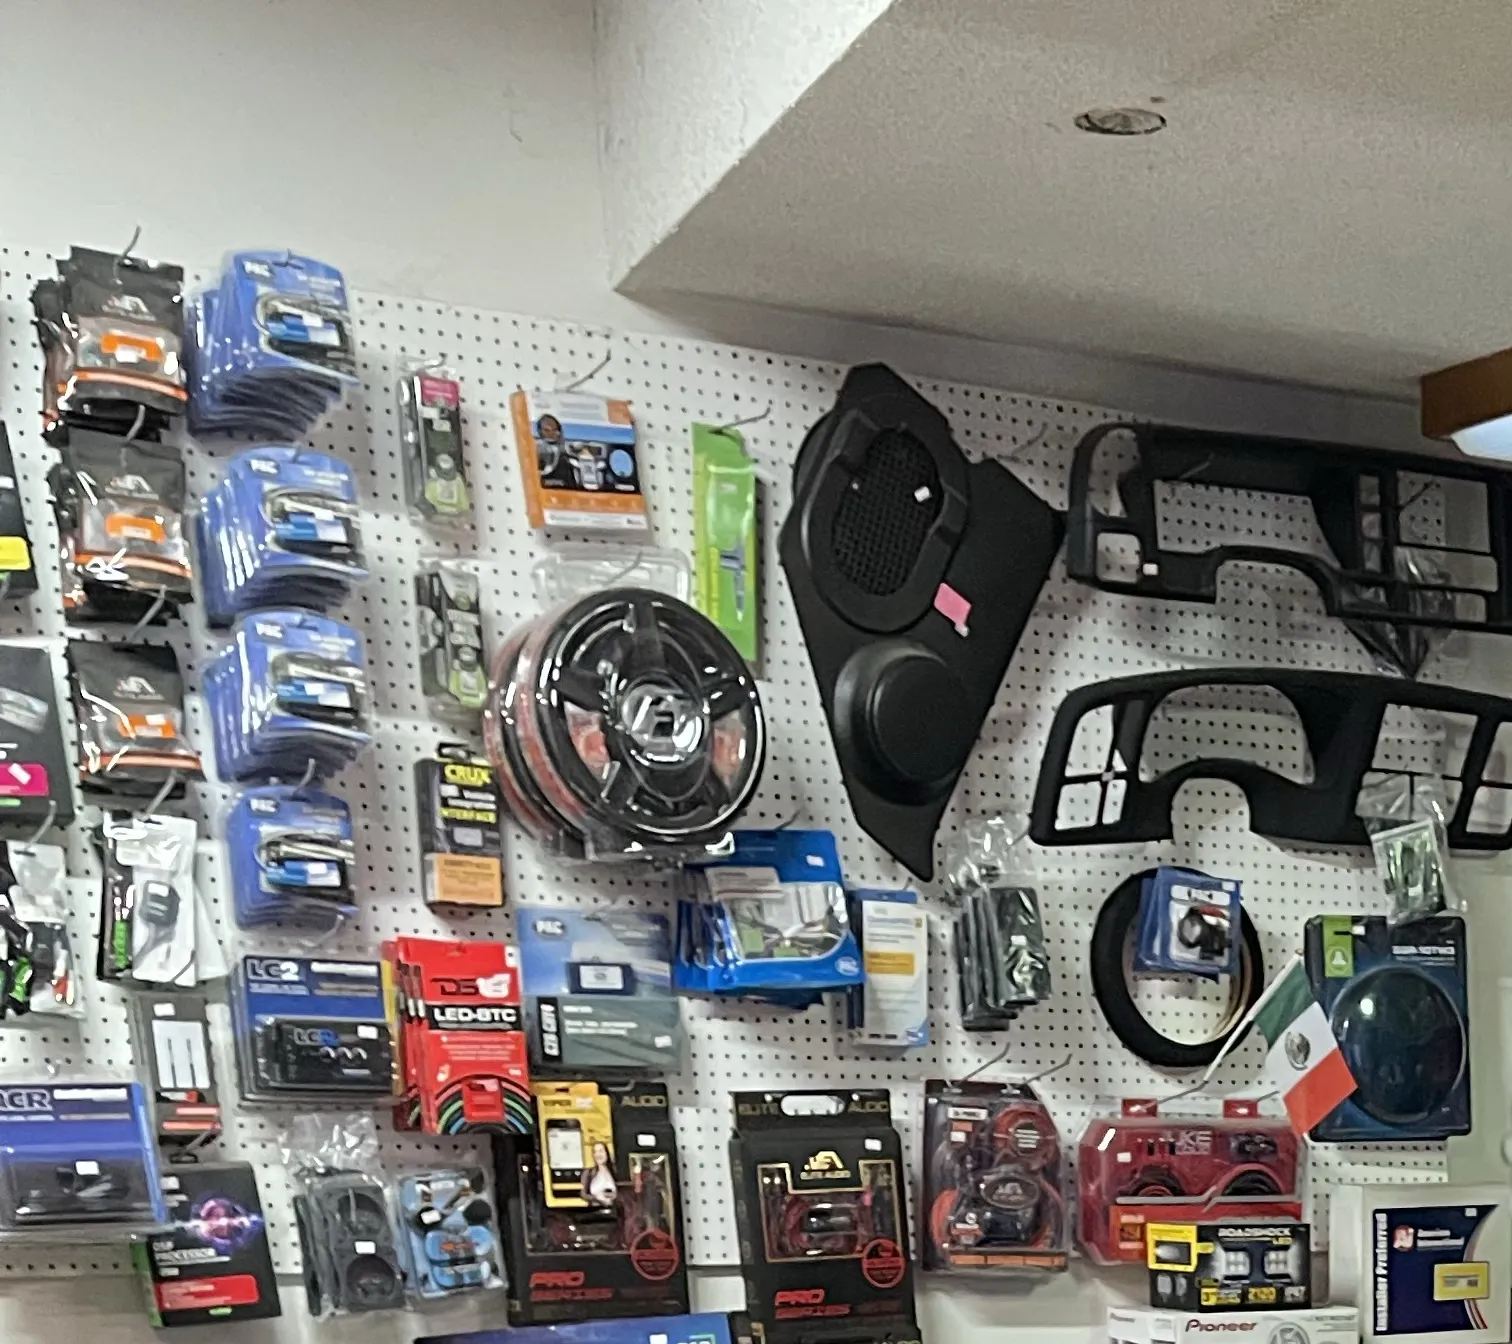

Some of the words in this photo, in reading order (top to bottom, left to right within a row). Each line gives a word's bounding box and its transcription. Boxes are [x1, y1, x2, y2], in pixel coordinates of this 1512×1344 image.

[444, 764, 492, 786] CRUX
[434, 1007, 517, 1022] LED-BTC
[1185, 1318, 1257, 1333] Pioneer
